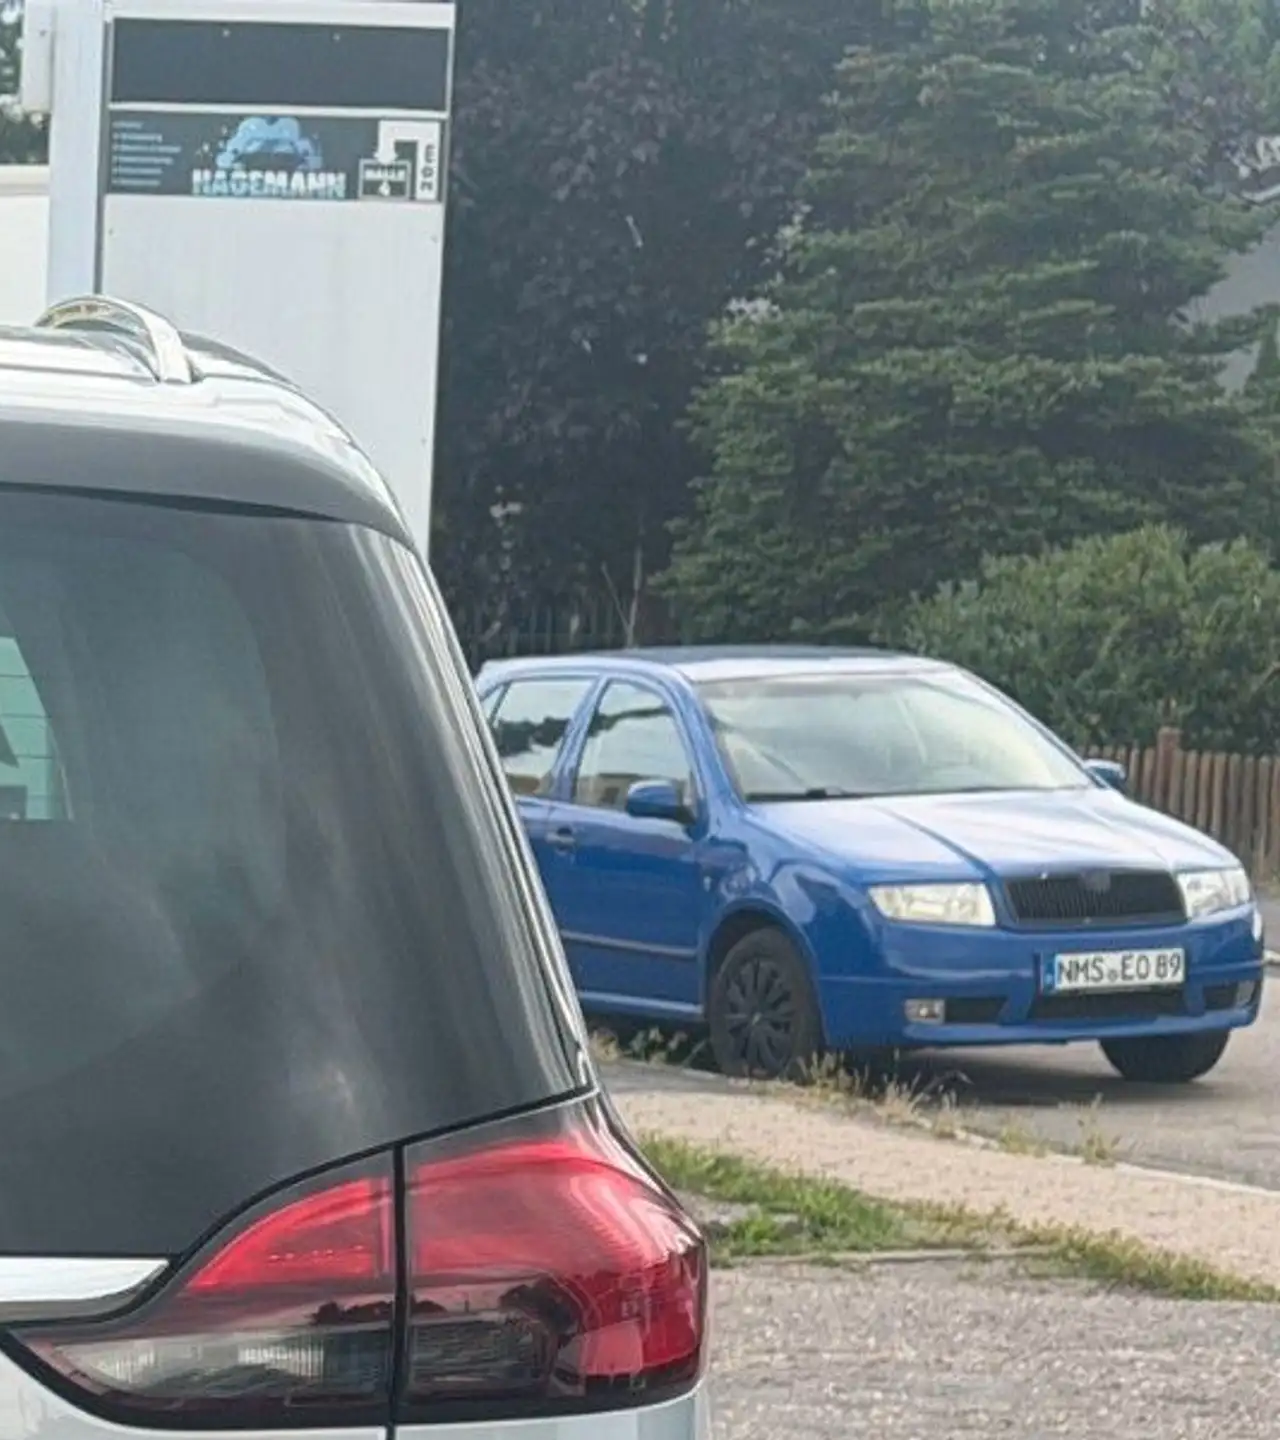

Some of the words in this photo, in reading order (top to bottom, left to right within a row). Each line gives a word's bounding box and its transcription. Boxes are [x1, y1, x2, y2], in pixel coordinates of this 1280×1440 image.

[192, 168, 346, 198] HAGEMANN
[1057, 955, 1105, 984] NMS
[1120, 952, 1151, 982] EO
[1154, 951, 1181, 979] 89
